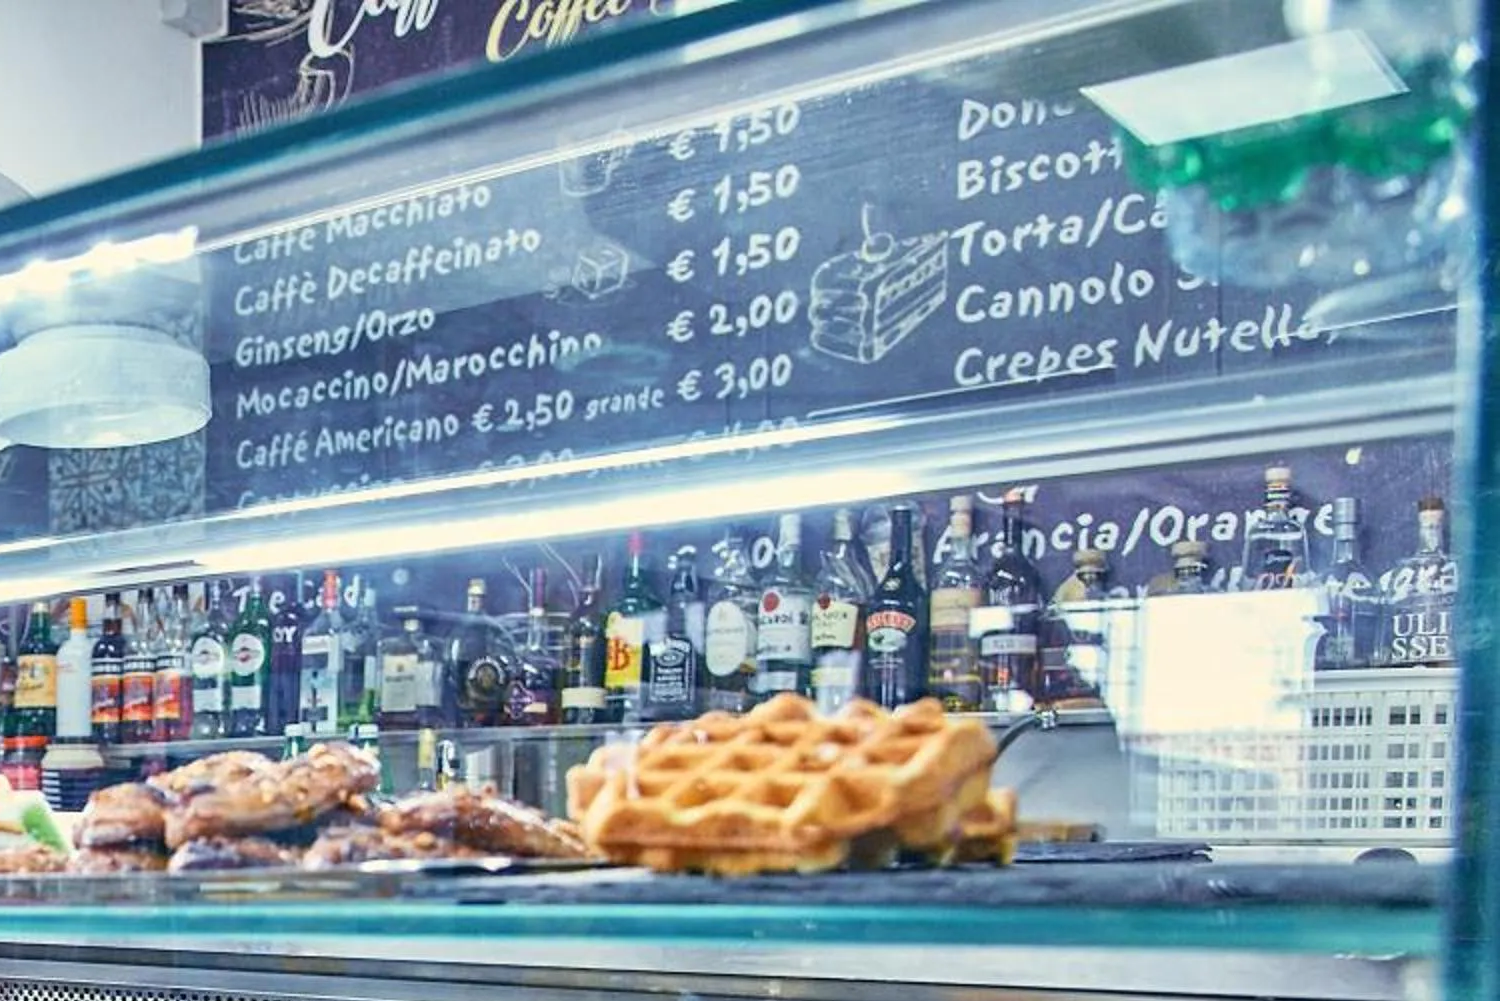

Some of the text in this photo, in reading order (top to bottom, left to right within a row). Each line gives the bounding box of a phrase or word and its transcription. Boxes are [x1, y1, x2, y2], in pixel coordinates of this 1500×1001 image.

[326, 185, 491, 244] Macchiato
[667, 130, 696, 161] €
[713, 101, 800, 152] 1,50
[957, 137, 1123, 200] Biscott
[234, 164, 800, 316] Caffè Decaffeinato € 1,50
[235, 226, 800, 367] Ginseng/Orzo € 1,50
[955, 261, 1154, 323] Cannolo
[236, 290, 798, 420] Mocaccino/Marocchino € 2,00
[314, 412, 459, 458] Americano
[472, 404, 494, 433] €
[504, 390, 574, 431] 2,50
[584, 387, 665, 421] grande
[677, 369, 701, 401] €
[714, 353, 793, 399] 3,00
[954, 336, 1119, 386] Crepes
